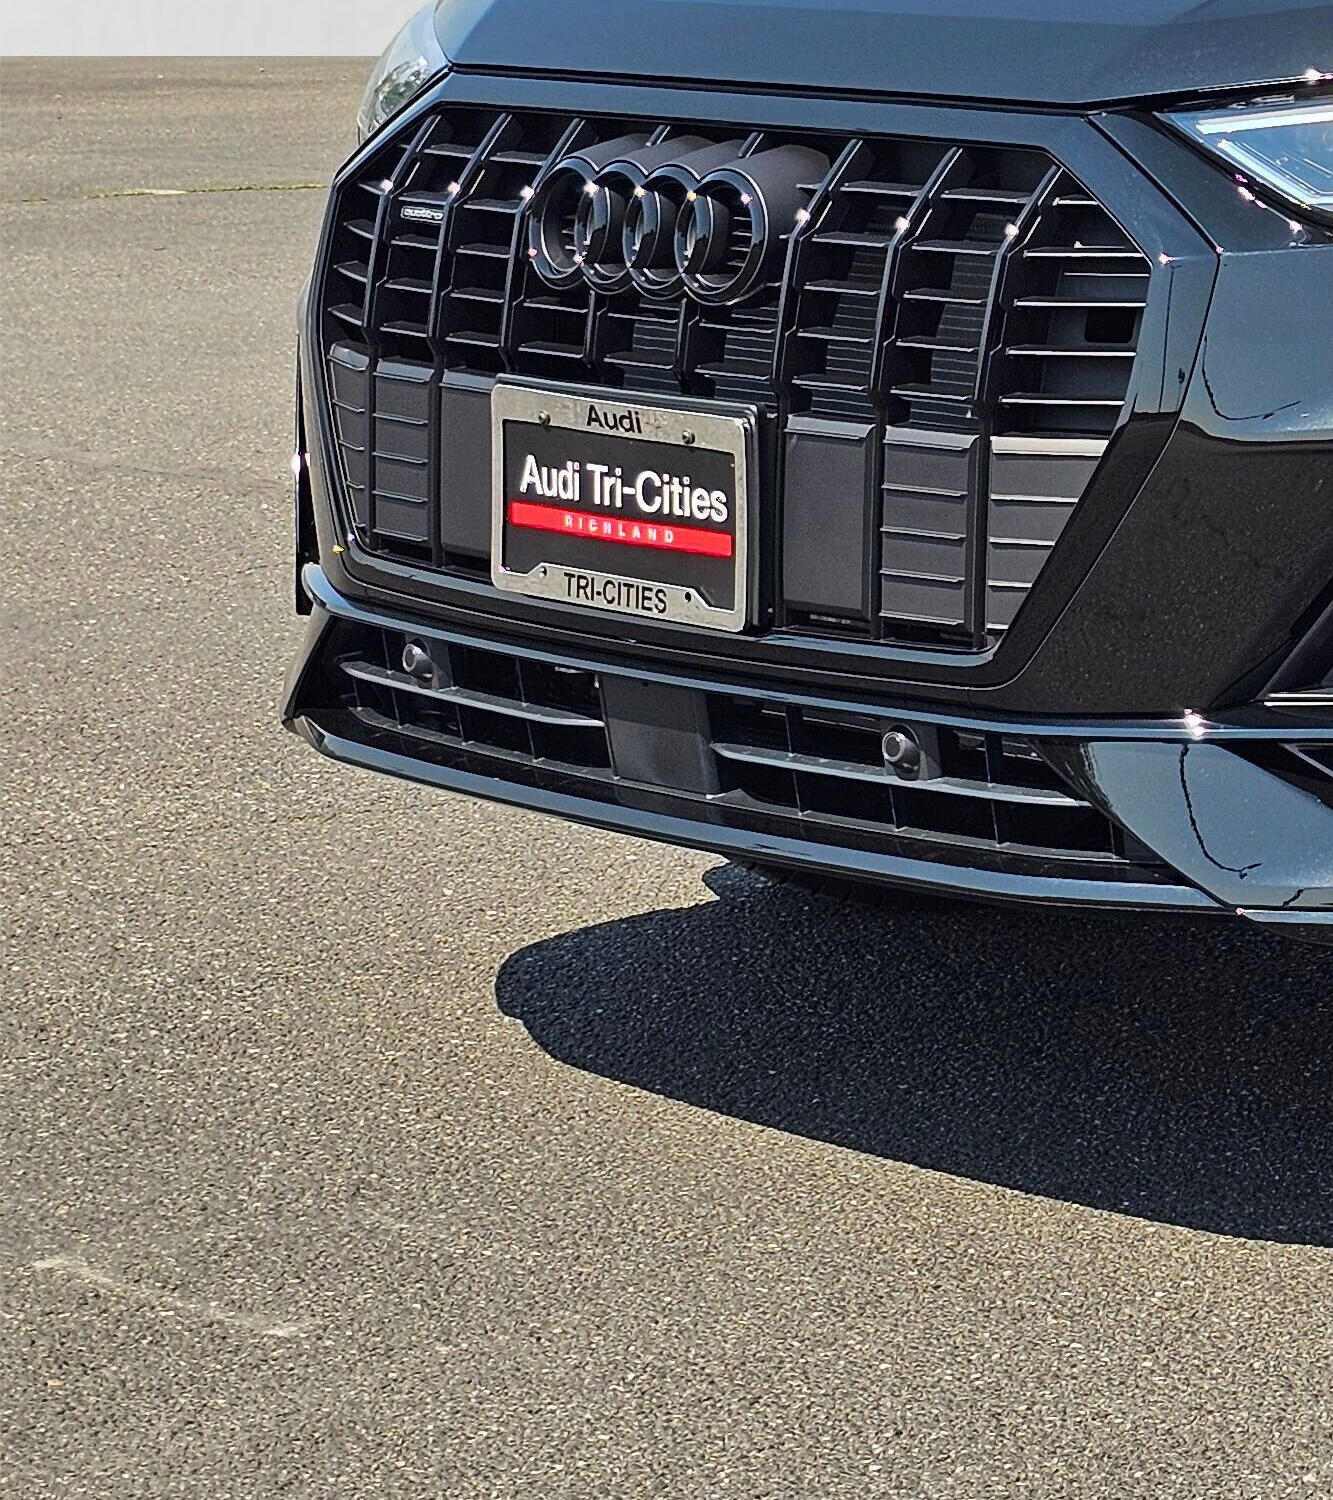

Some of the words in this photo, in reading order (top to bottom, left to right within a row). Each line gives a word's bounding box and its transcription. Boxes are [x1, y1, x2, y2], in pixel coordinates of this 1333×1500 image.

[586, 404, 642, 434] Audi
[520, 453, 580, 502] Audi
[586, 462, 729, 523] Tri-Cities
[564, 514, 674, 544] RICHLAND
[563, 571, 668, 614] TRI-CITIES
